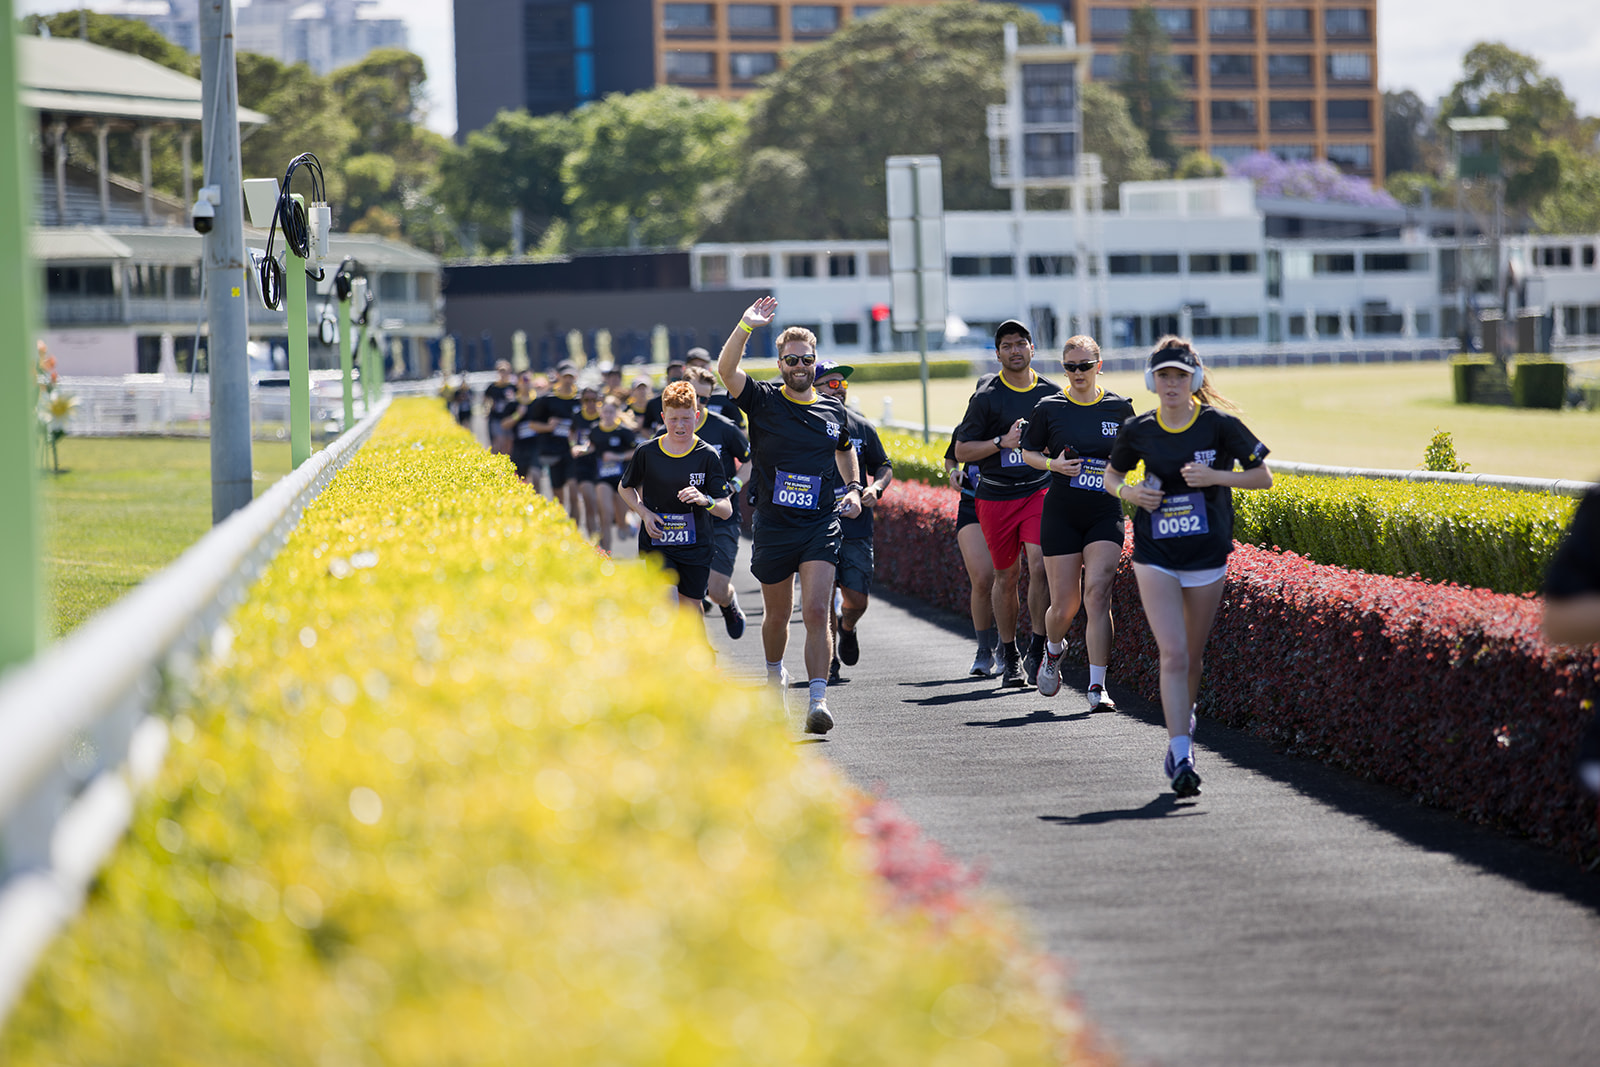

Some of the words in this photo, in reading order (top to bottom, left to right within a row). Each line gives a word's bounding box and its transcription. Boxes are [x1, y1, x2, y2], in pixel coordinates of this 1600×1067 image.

[1009, 452, 1024, 464] 01
[1194, 450, 1216, 460] STEP
[1079, 473, 1106, 488] 009
[779, 490, 813, 506] 0033
[1159, 515, 1201, 534] 0092
[659, 530, 689, 543] 0241
